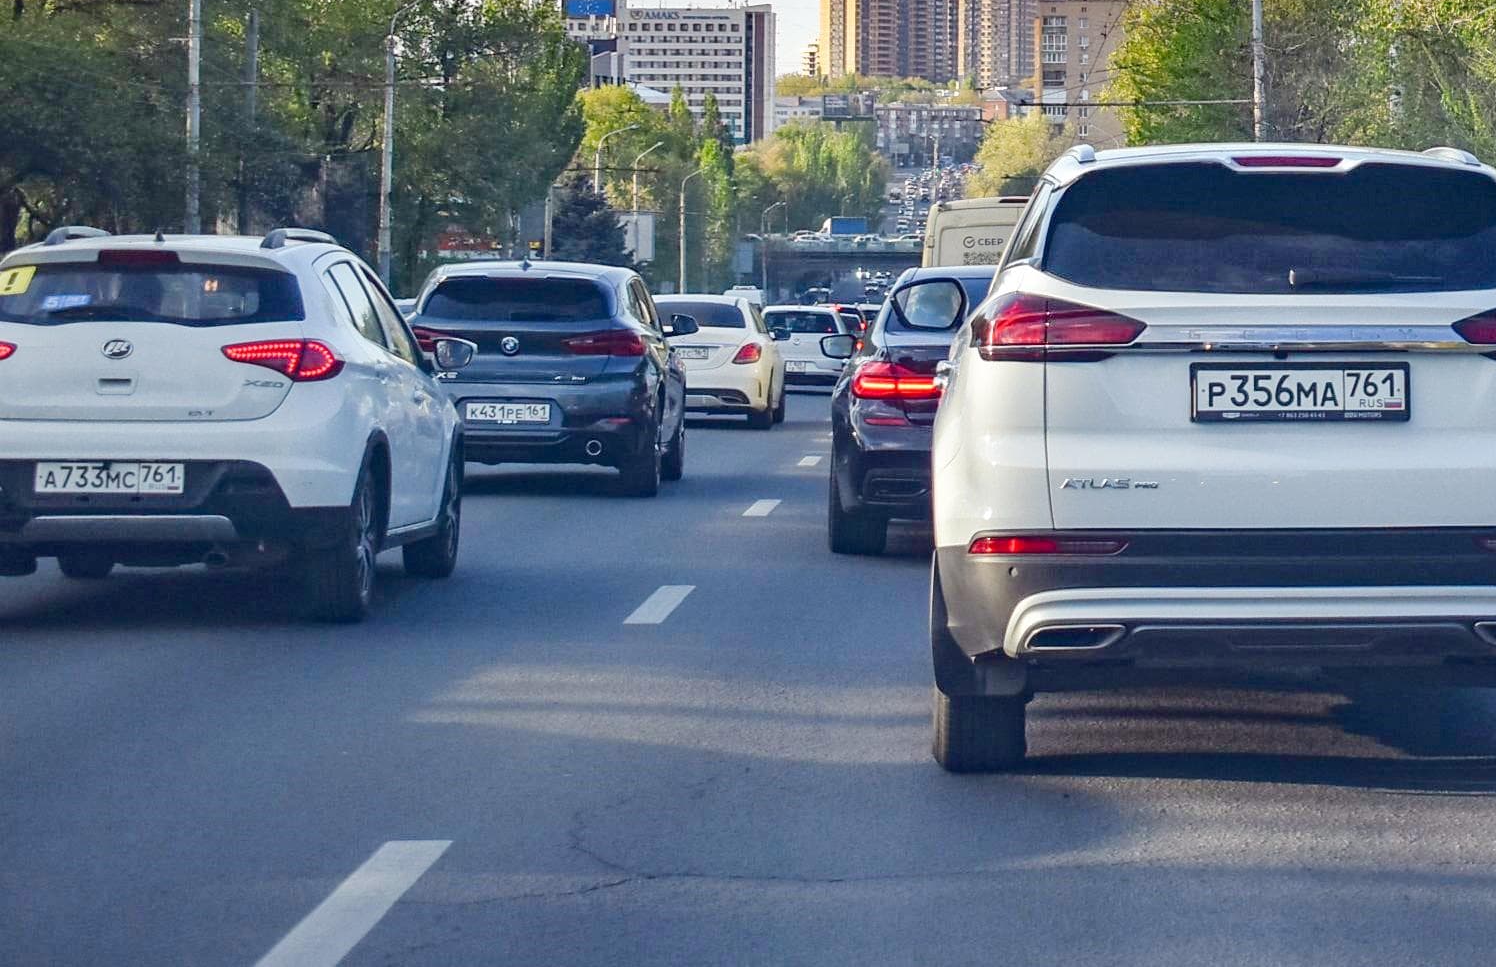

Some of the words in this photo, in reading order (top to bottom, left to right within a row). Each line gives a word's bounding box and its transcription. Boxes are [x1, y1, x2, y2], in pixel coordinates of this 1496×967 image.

[643, 10, 680, 20] AMAKS
[977, 238, 1004, 246] СБЕР
[1208, 374, 1339, 407] Р356МА
[1346, 372, 1395, 397] 761
[1360, 399, 1384, 408] RUS
[470, 405, 523, 419] К431РЕ
[526, 405, 547, 416] 161
[44, 465, 136, 489] А733МС
[142, 465, 176, 482] 761
[1060, 478, 1131, 489] ATLAS
[1134, 481, 1160, 489] PRO
